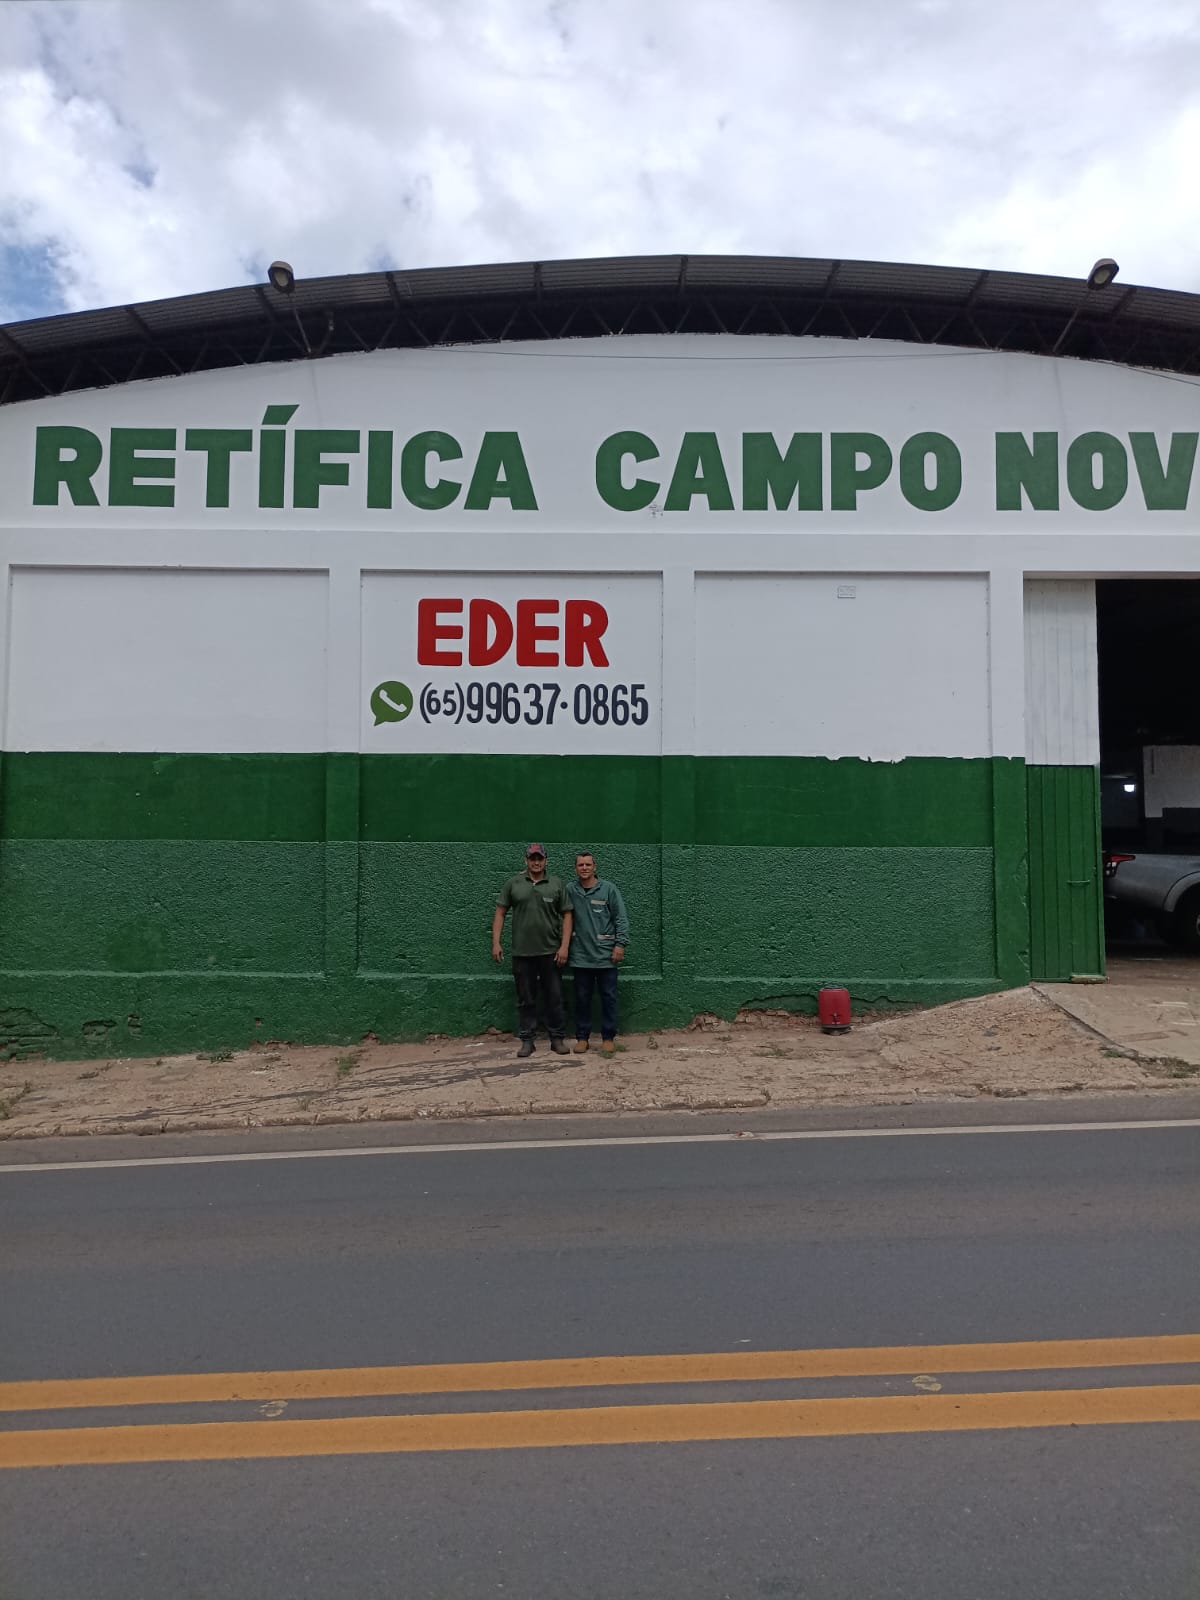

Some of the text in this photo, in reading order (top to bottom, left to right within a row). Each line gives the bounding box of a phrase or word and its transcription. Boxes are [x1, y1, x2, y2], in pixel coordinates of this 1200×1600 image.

[33, 404, 1199, 512] RETÍFICA CAMPO NOV
[417, 598, 610, 668] EDER
